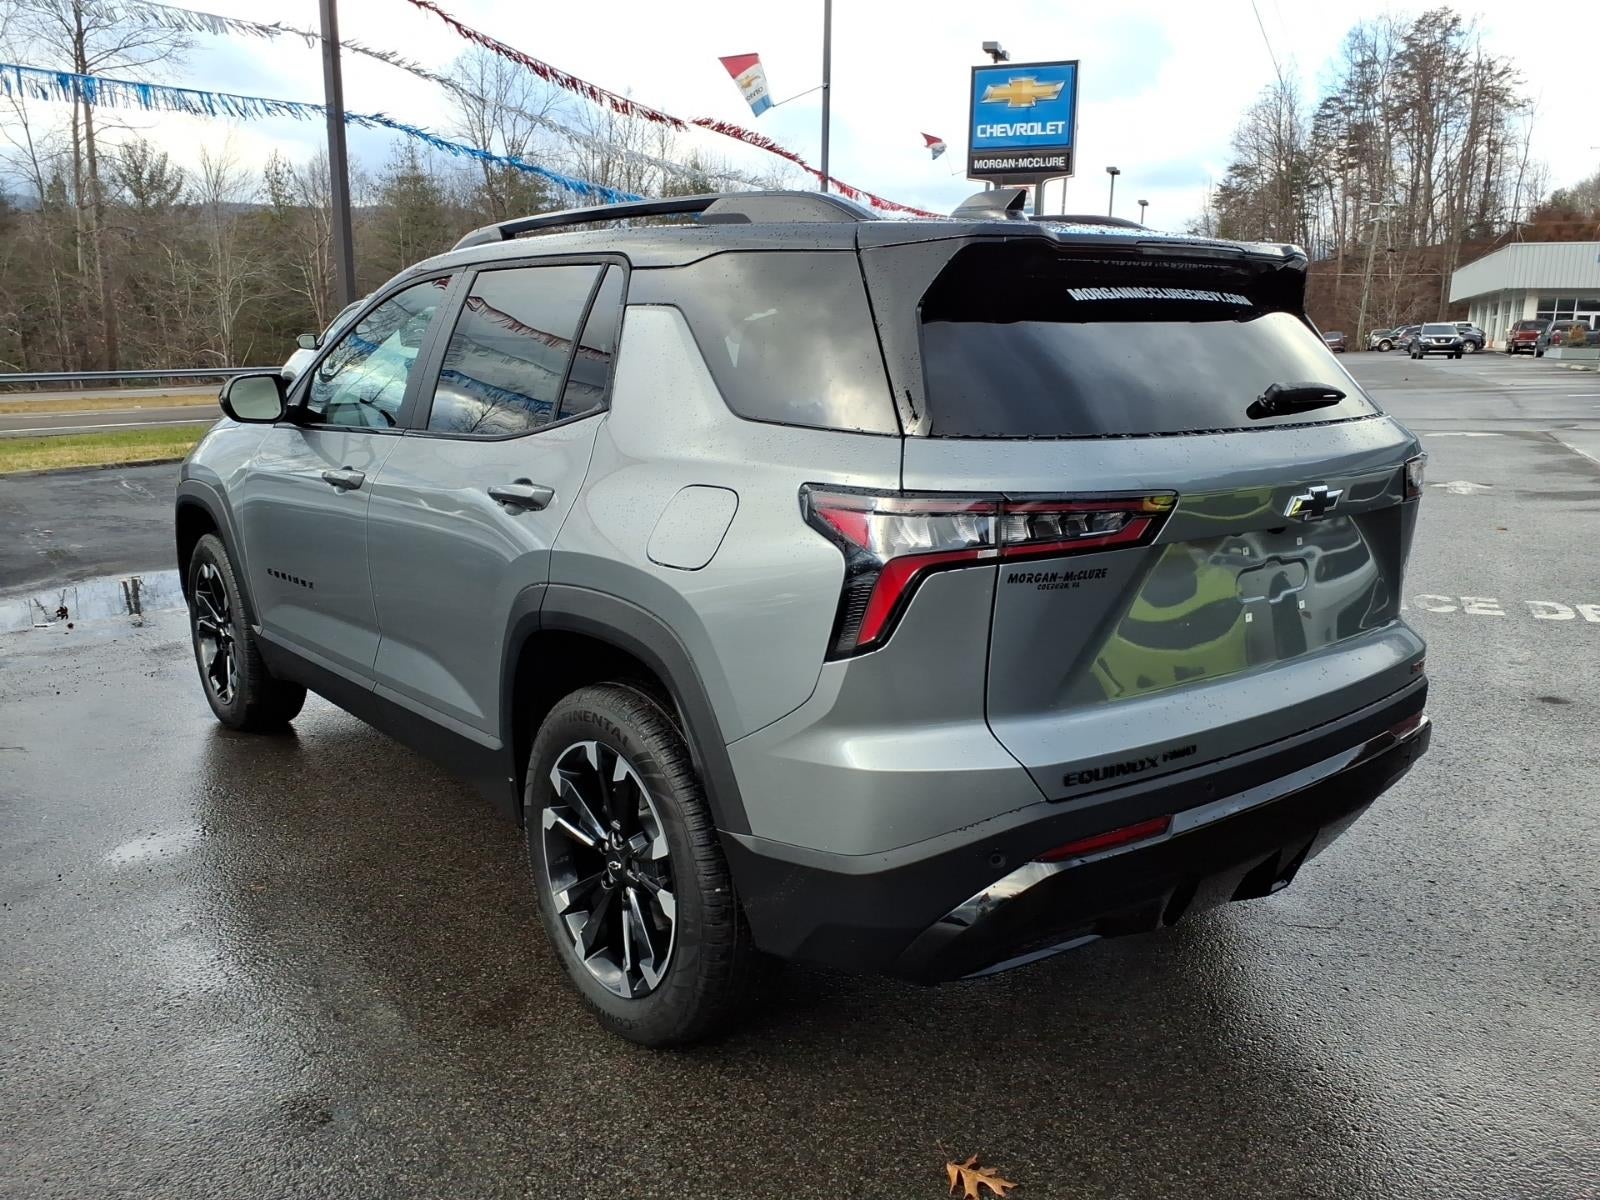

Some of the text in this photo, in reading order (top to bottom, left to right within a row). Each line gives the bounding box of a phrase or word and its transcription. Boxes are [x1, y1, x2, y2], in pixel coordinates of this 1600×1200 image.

[976, 121, 1065, 138] CHEVROLET
[974, 156, 1065, 169] MORGAN-MCCLURE
[1066, 286, 1253, 306] MORGANMCCLURECHEVY.COM
[1401, 594, 1505, 616] CE
[1063, 755, 1159, 787] EQUINOX
